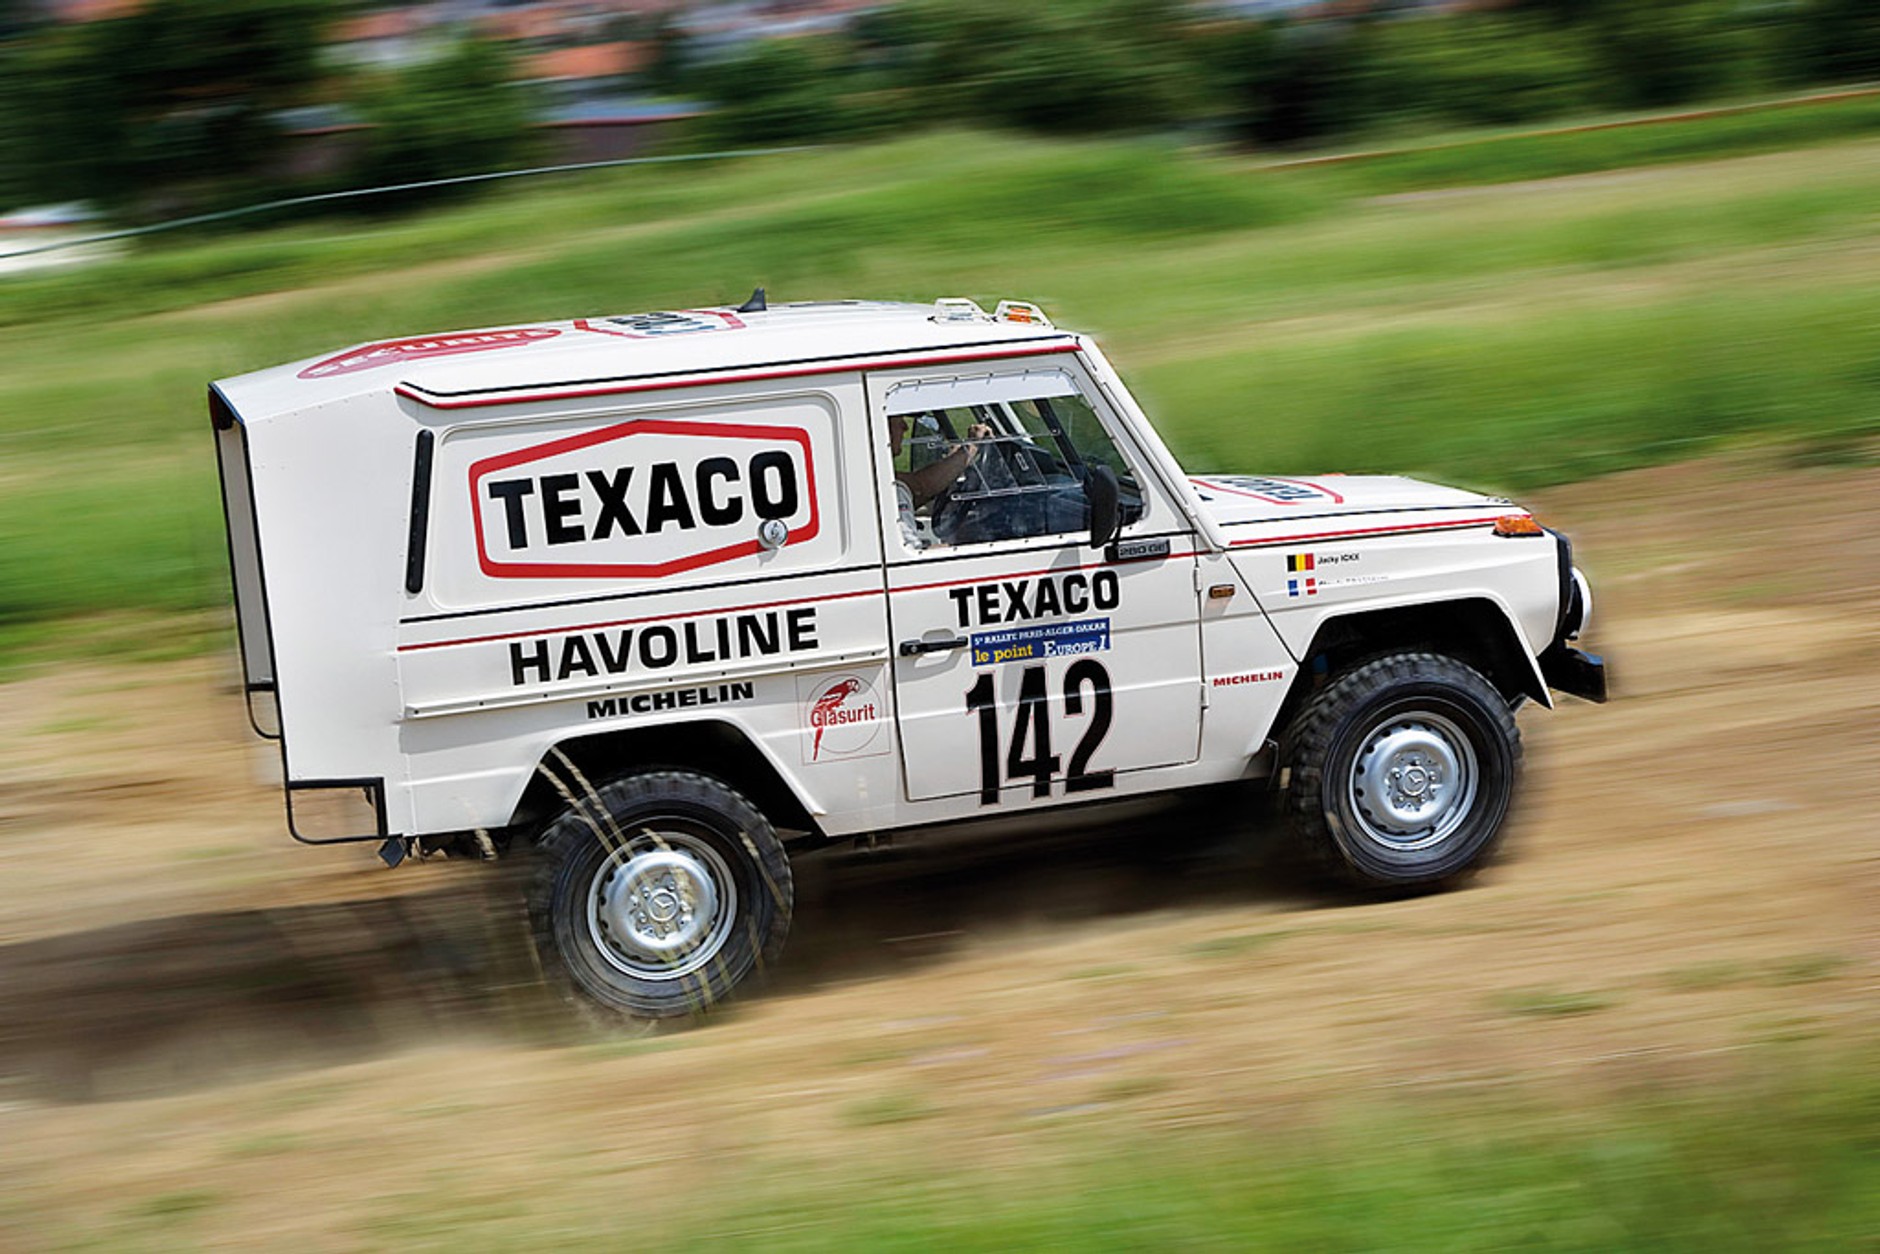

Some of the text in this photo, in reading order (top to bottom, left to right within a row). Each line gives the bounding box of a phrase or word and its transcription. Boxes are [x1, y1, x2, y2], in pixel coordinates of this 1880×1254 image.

[488, 450, 799, 550] TEXACO
[949, 570, 1119, 628] TEXACO
[509, 607, 819, 686] HAVOLINE
[975, 644, 1033, 663] le point
[587, 681, 754, 719] MICHELIN
[1213, 671, 1283, 687] MICHELIN
[810, 703, 875, 728] Glasurit
[965, 657, 1117, 806] 142
